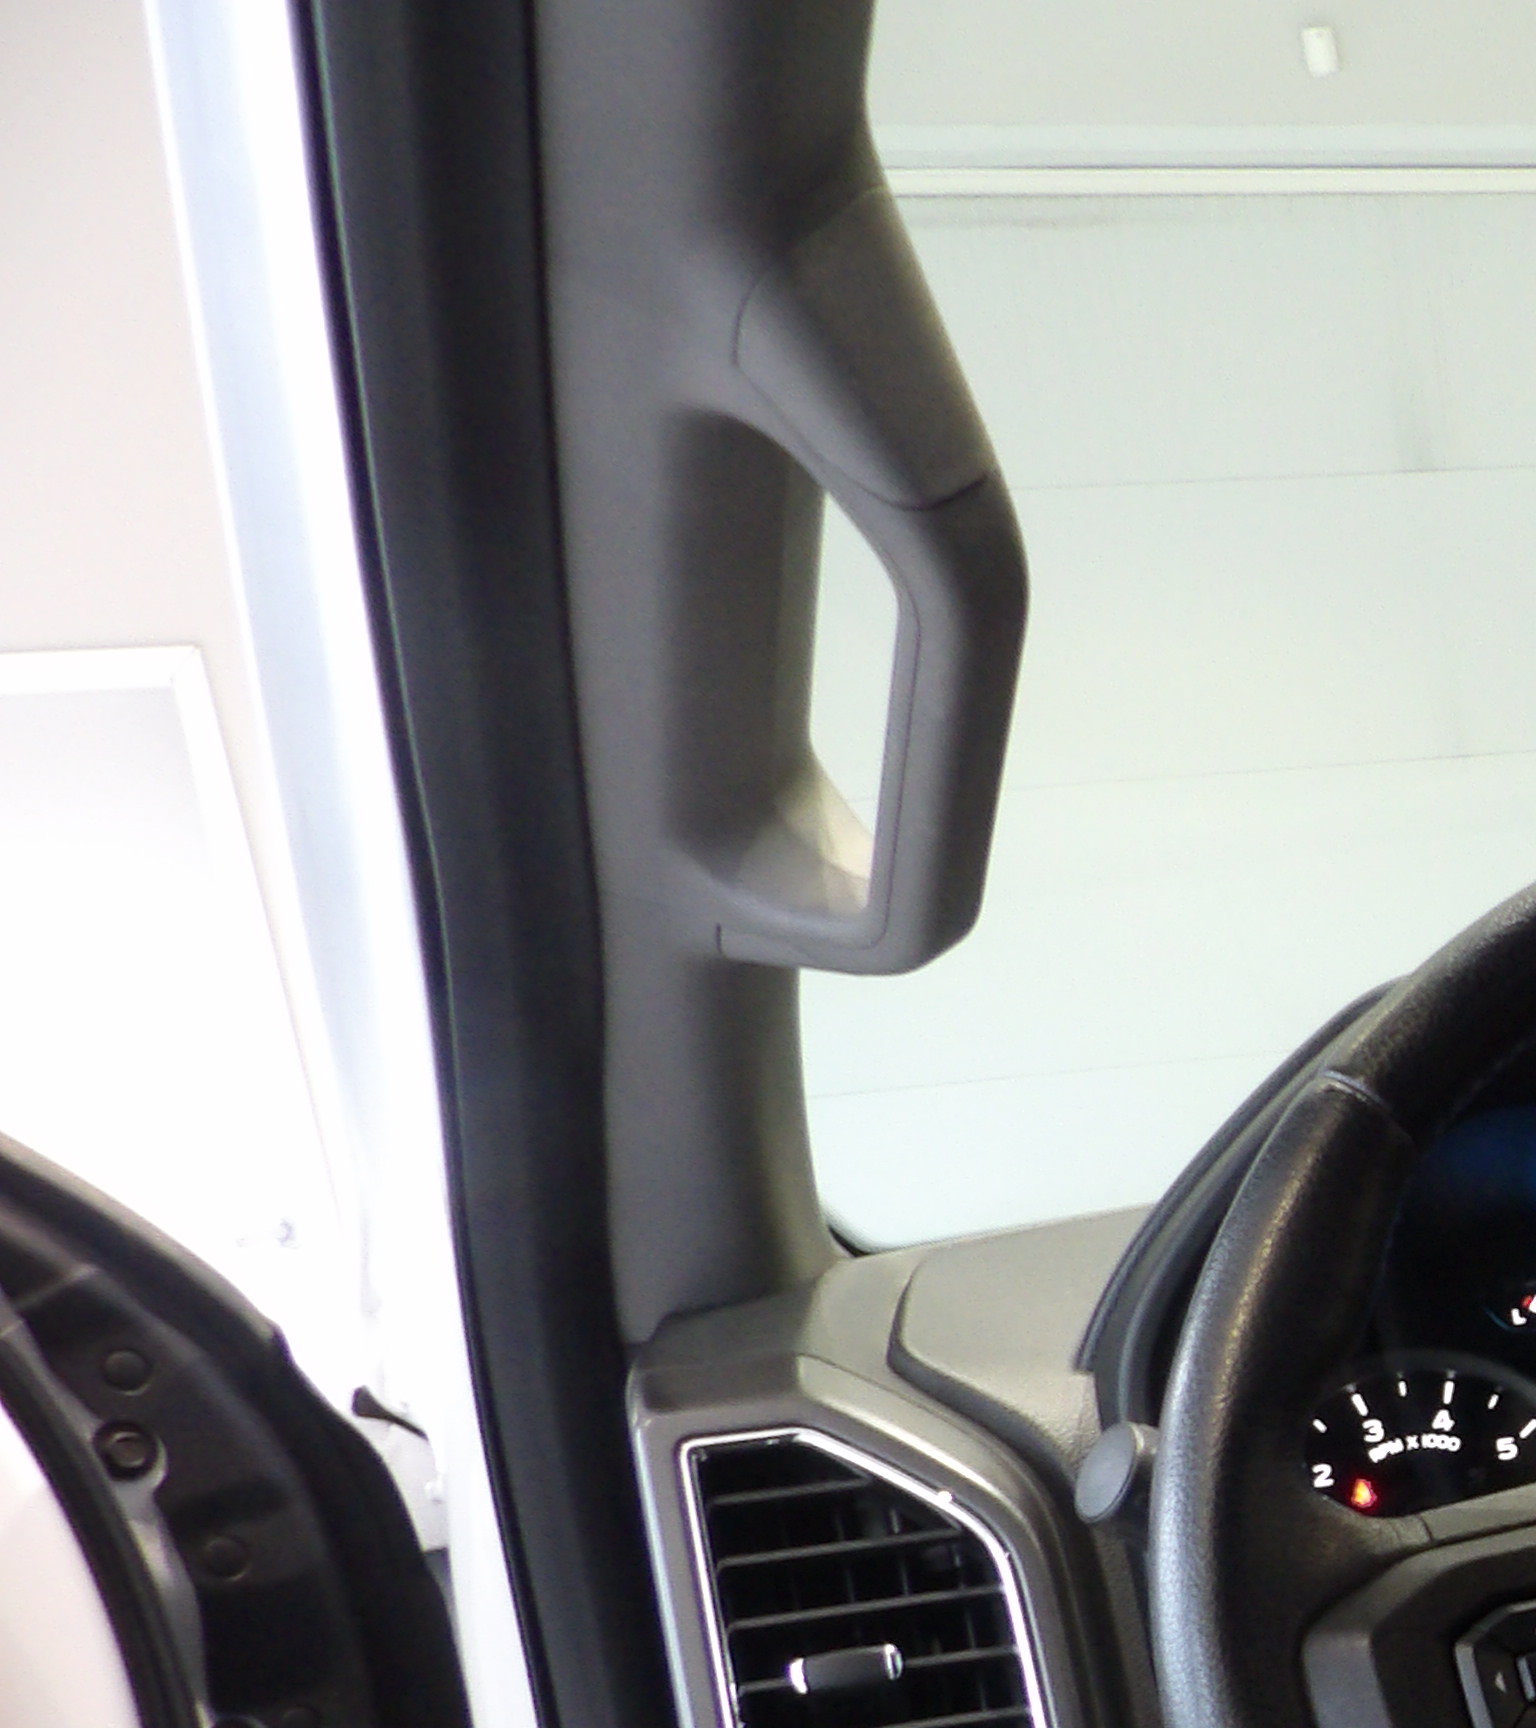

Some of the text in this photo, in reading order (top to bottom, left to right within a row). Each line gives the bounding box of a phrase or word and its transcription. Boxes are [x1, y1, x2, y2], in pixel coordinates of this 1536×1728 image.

[1512, 1309, 1527, 1326] L
[1363, 1419, 1385, 1443] 3
[1432, 1409, 1455, 1432] 4
[1368, 1438, 1405, 1464] RPM
[1421, 1432, 1462, 1453] 1000
[1496, 1437, 1519, 1461] 5
[1312, 1463, 1334, 1489] 2
